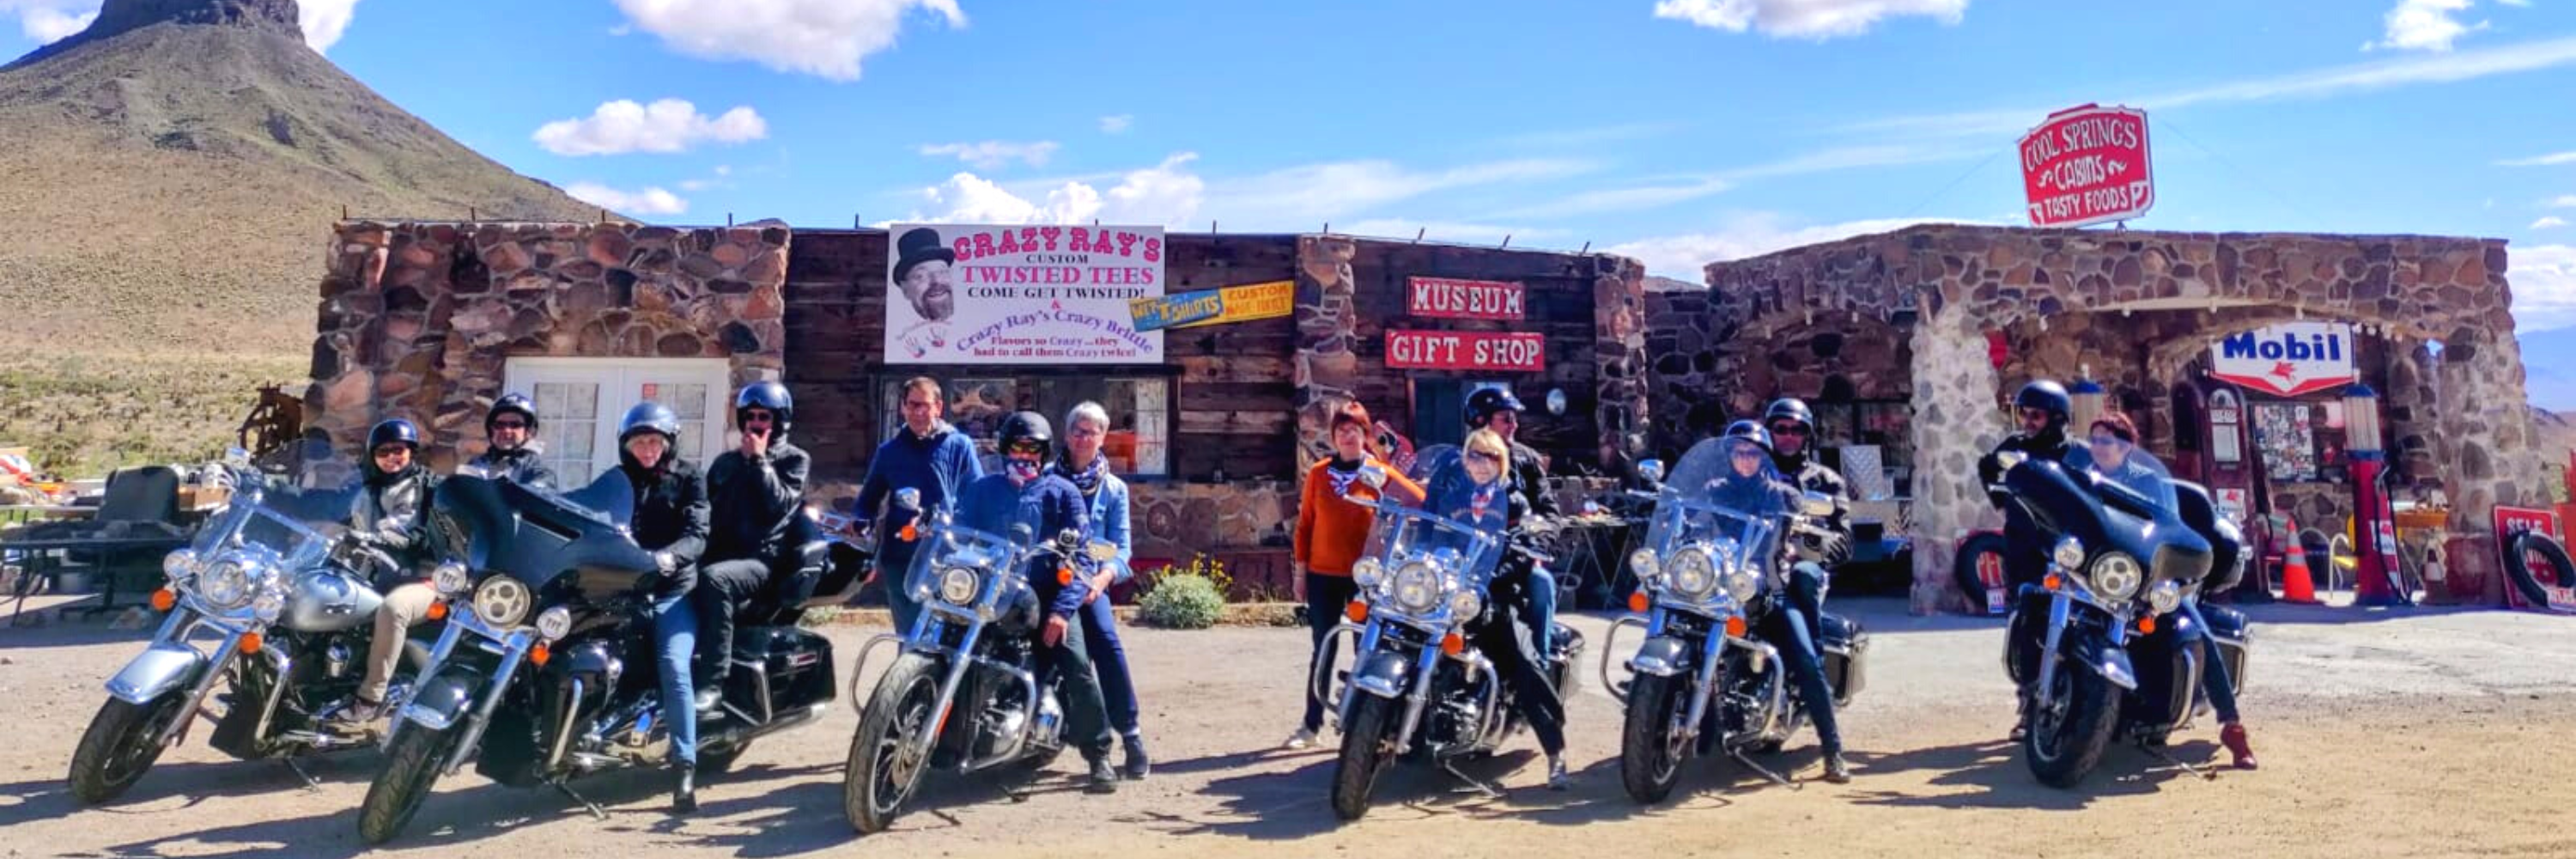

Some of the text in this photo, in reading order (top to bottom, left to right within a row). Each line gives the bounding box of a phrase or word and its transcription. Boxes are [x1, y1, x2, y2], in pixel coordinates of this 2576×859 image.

[2026, 119, 2137, 172] COOL SPRINGS
[2055, 154, 2105, 191] CABINS
[2044, 186, 2128, 218] TASTY FOODS
[953, 226, 1160, 263] CRAZY RAY'S
[1026, 254, 1088, 264] CUSTOM
[961, 265, 1154, 284] TWISTED TEES
[968, 286, 1145, 299] COME GET TWISTED!
[1228, 284, 1289, 301] CUSTOM
[1413, 283, 1522, 314] MUSEUM
[957, 309, 1153, 354] Crazy Ray's Crazy Brittle
[992, 336, 1032, 345] Flavors
[1049, 337, 1083, 347] Crazy
[974, 348, 994, 356] had
[1012, 348, 1033, 356] call
[1036, 348, 1064, 356] them
[1066, 348, 1098, 358] Crazy
[1392, 335, 1540, 365] GIFT SHOP
[2222, 332, 2342, 361] Mobil
